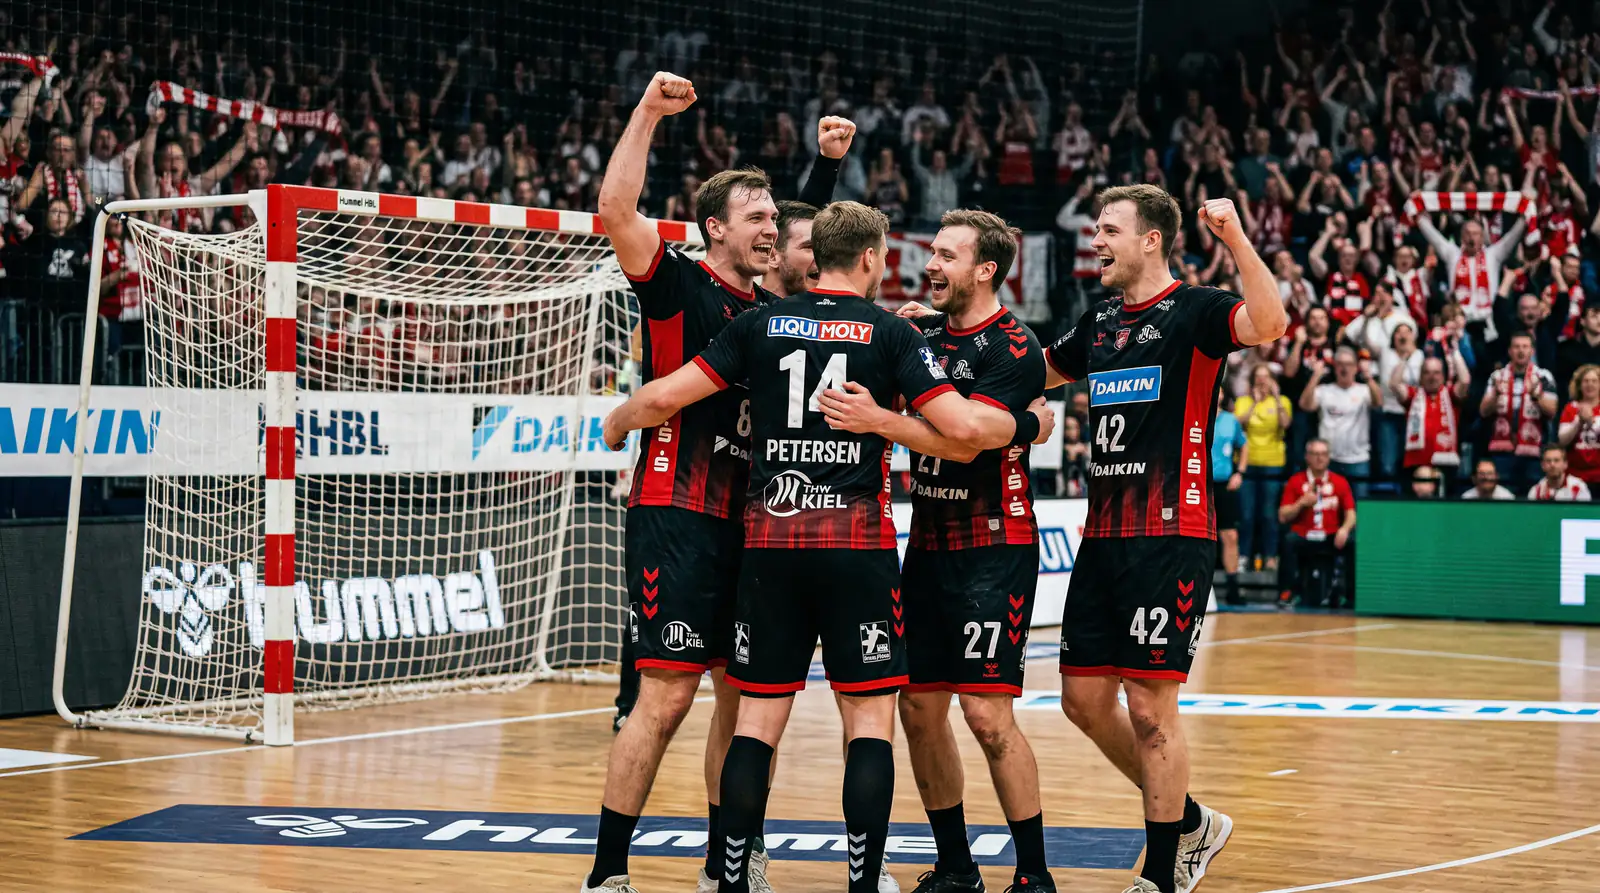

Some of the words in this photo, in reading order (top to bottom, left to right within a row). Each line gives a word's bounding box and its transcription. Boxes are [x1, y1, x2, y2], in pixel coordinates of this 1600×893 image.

[770, 318, 818, 338] LIQUI
[820, 323, 870, 341] MOLY
[779, 349, 847, 430] 14
[1096, 377, 1155, 396] DAIKIN
[511, 415, 629, 453] DAIK
[1095, 413, 1126, 453] 42
[766, 438, 861, 464] PETERSEN
[1094, 462, 1146, 477] DAIKIN
[803, 484, 832, 493] THW
[917, 483, 969, 500] DAIKIN
[801, 494, 848, 509] KIEL
[1129, 606, 1169, 645] 42
[686, 638, 705, 648] KIEL
[963, 621, 1001, 659] 27
